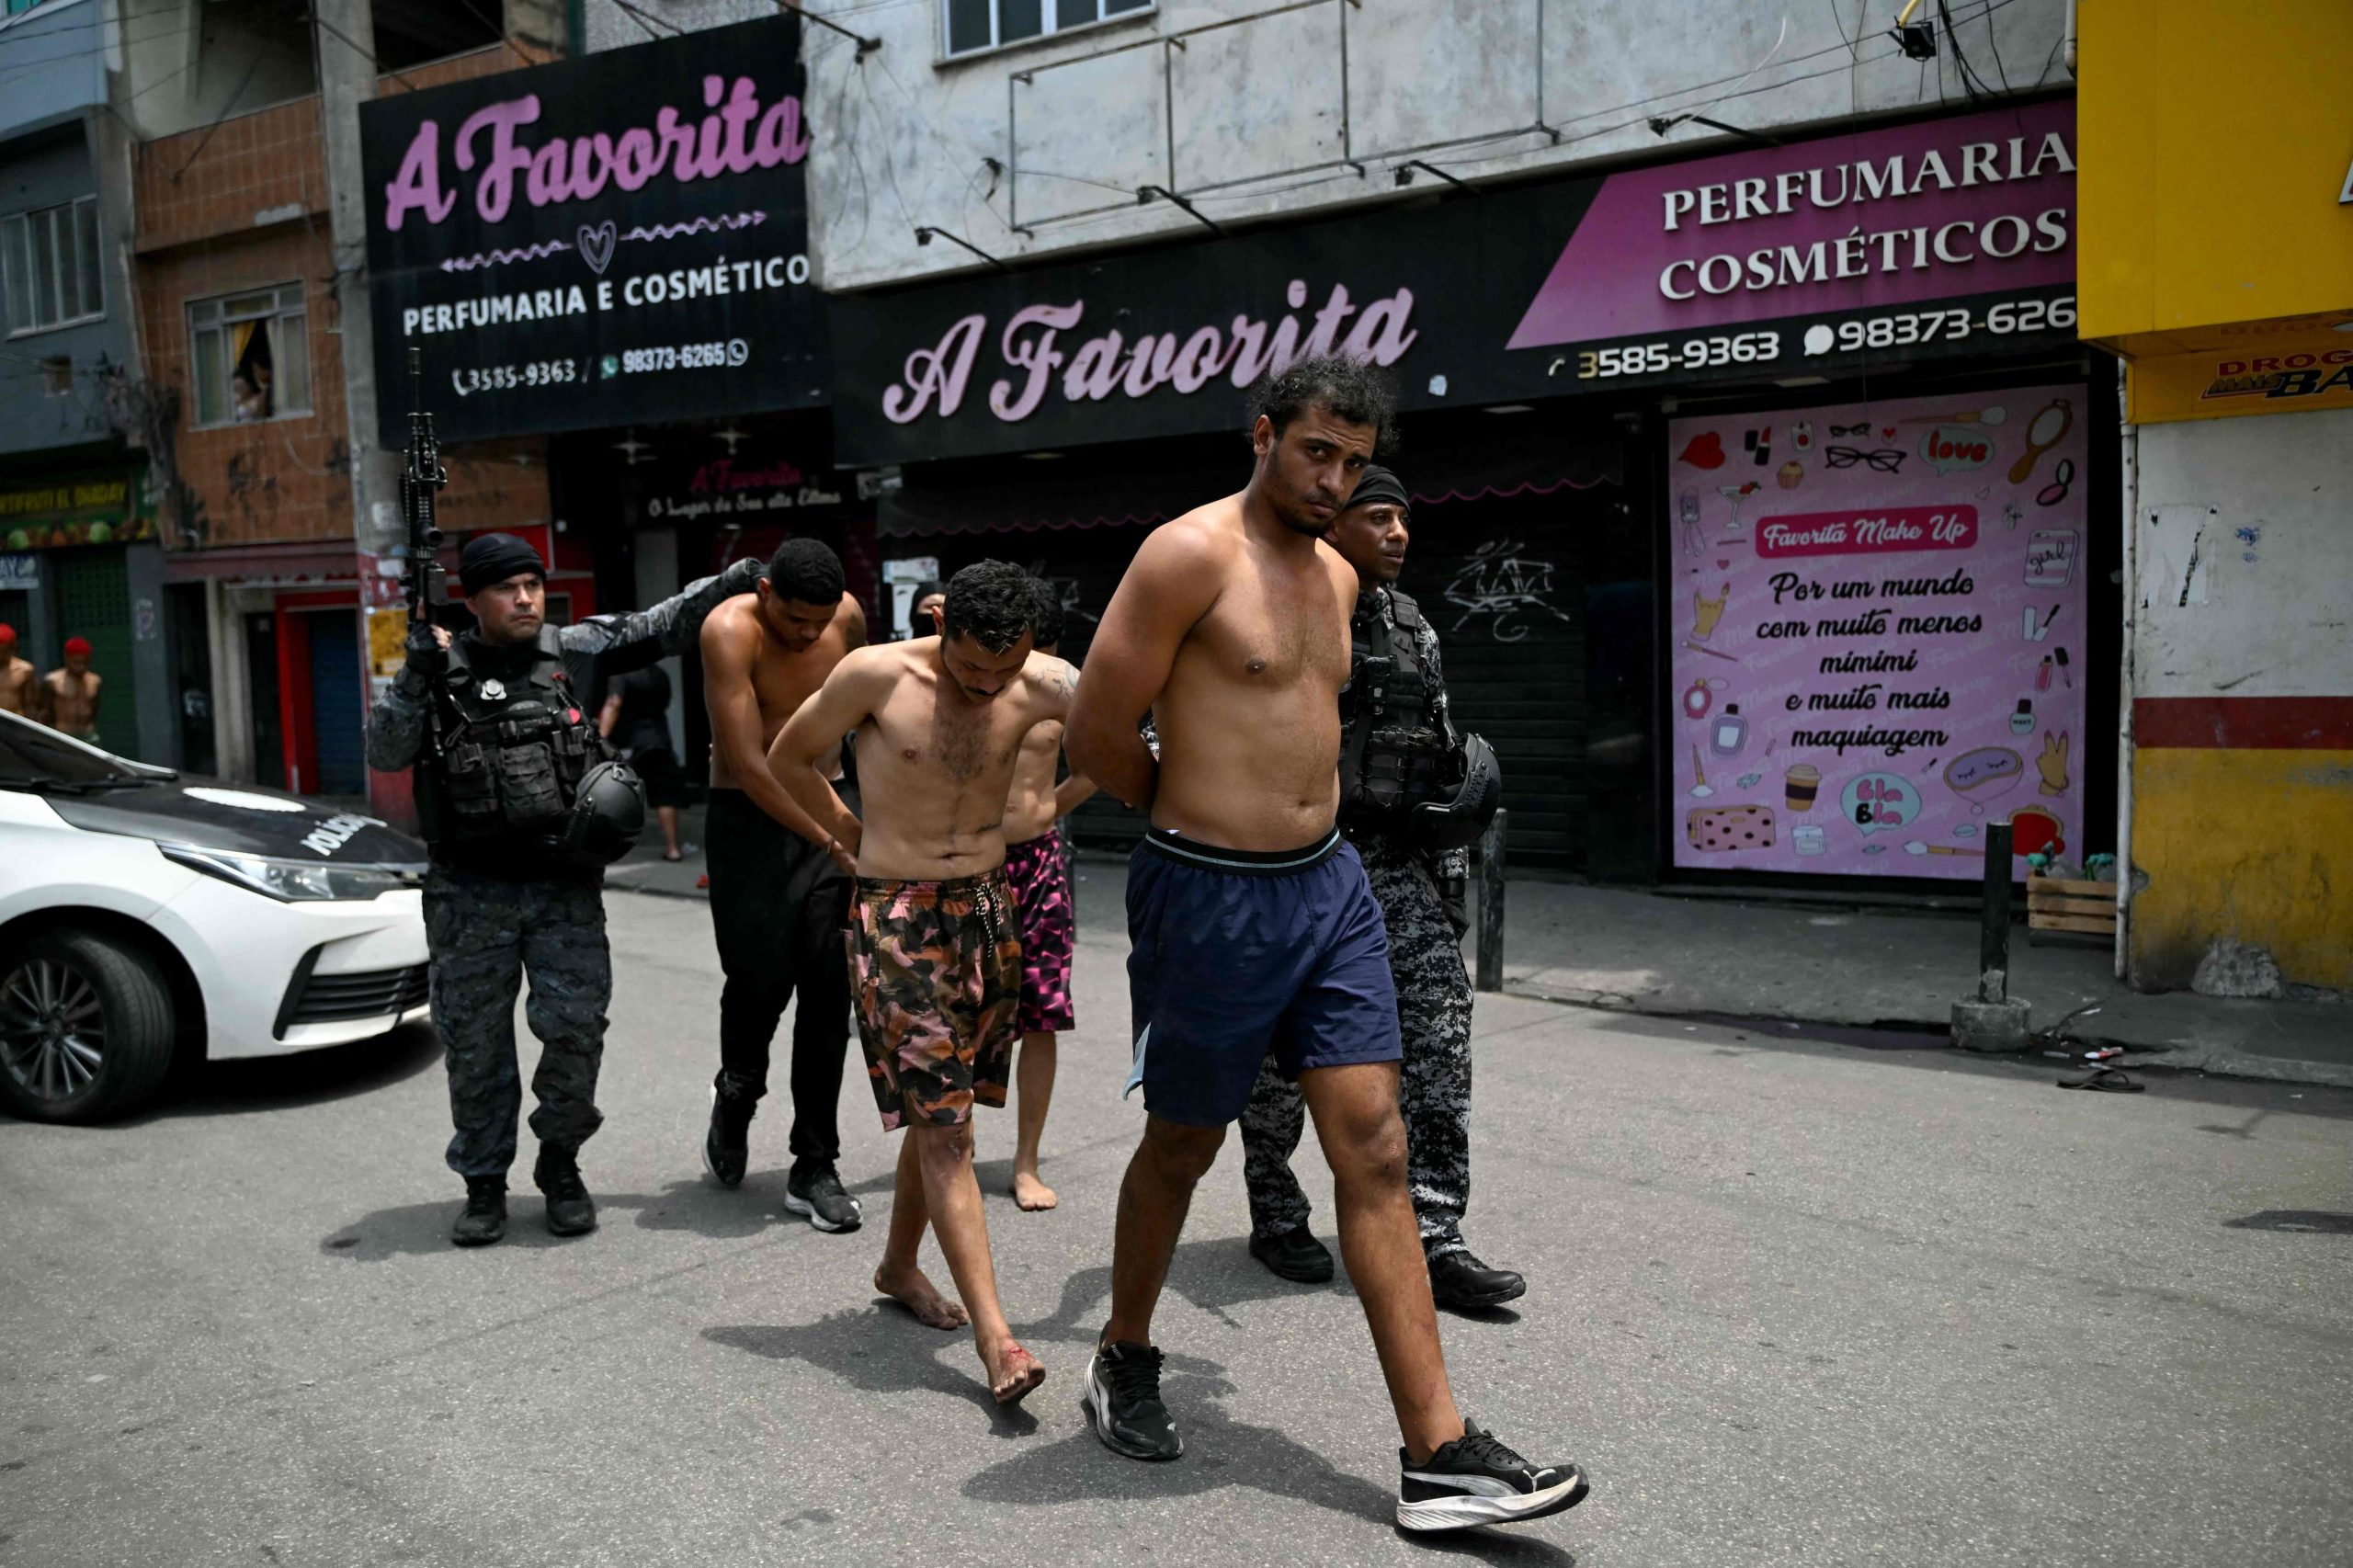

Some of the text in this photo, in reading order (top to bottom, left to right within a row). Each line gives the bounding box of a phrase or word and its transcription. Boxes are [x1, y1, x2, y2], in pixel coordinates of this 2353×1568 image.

[384, 74, 813, 232] A Favorita
[1662, 131, 2076, 233] PERFUMARIA
[1659, 208, 2070, 301] COSMÉTICOS
[403, 284, 587, 337] PERFUMARIA
[597, 280, 614, 312] E
[469, 358, 576, 393] 3585-9363
[622, 342, 726, 375] 98373-6265
[881, 278, 1418, 425] A Favorita
[1577, 331, 1779, 380] 3585-9363
[1929, 427, 1988, 462] love
[1763, 513, 1968, 551] Favorita Make Up
[1768, 572, 1825, 606] Por
[1832, 577, 1876, 599] um
[1881, 567, 1974, 598] mundo
[1756, 617, 1810, 640] com
[1816, 608, 1893, 637] muito
[1896, 611, 1983, 635] menos
[1819, 648, 1918, 676] mimimi
[1785, 691, 1803, 711] e
[1809, 684, 1883, 710] muito
[1887, 684, 1950, 710] mais
[1791, 725, 1949, 756] maquiagem
